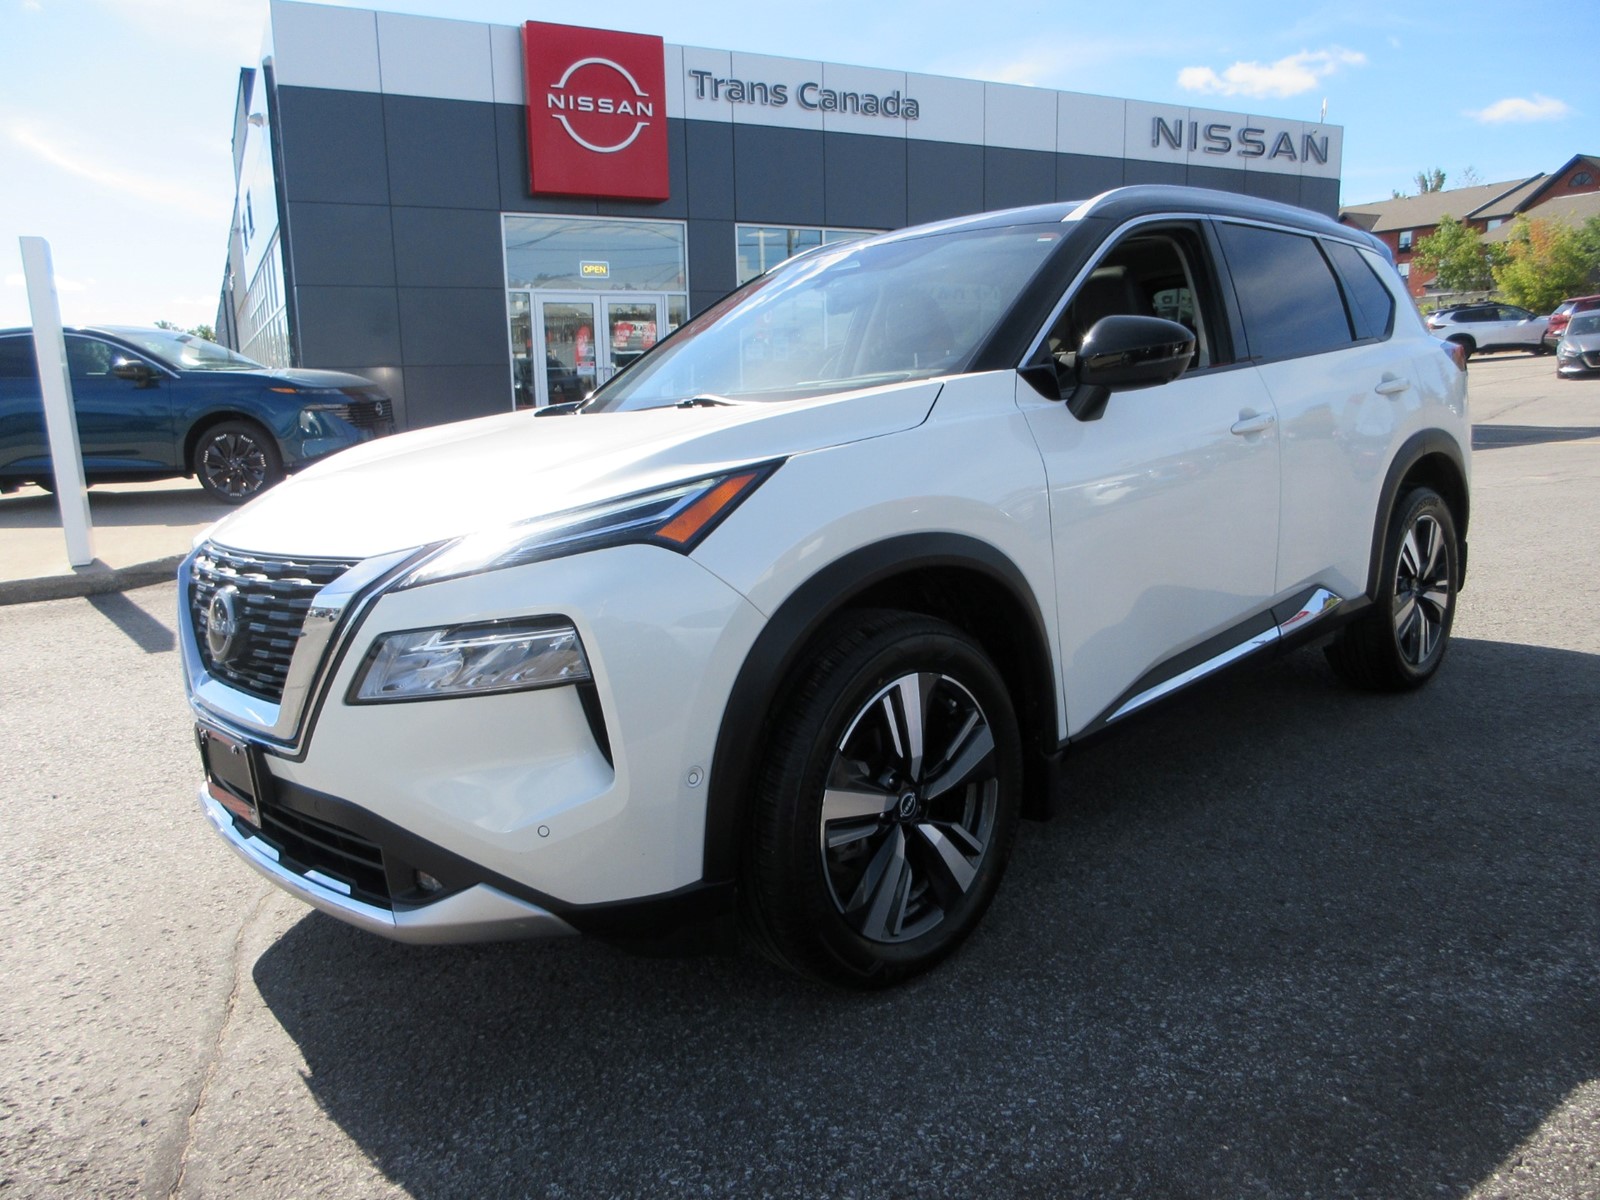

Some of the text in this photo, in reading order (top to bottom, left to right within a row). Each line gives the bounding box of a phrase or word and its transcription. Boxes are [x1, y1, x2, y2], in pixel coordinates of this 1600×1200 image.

[547, 93, 653, 117] NISSAN
[690, 69, 920, 120] Trans Canada
[1152, 116, 1329, 165] NISSAN
[583, 265, 606, 274] OPEN
